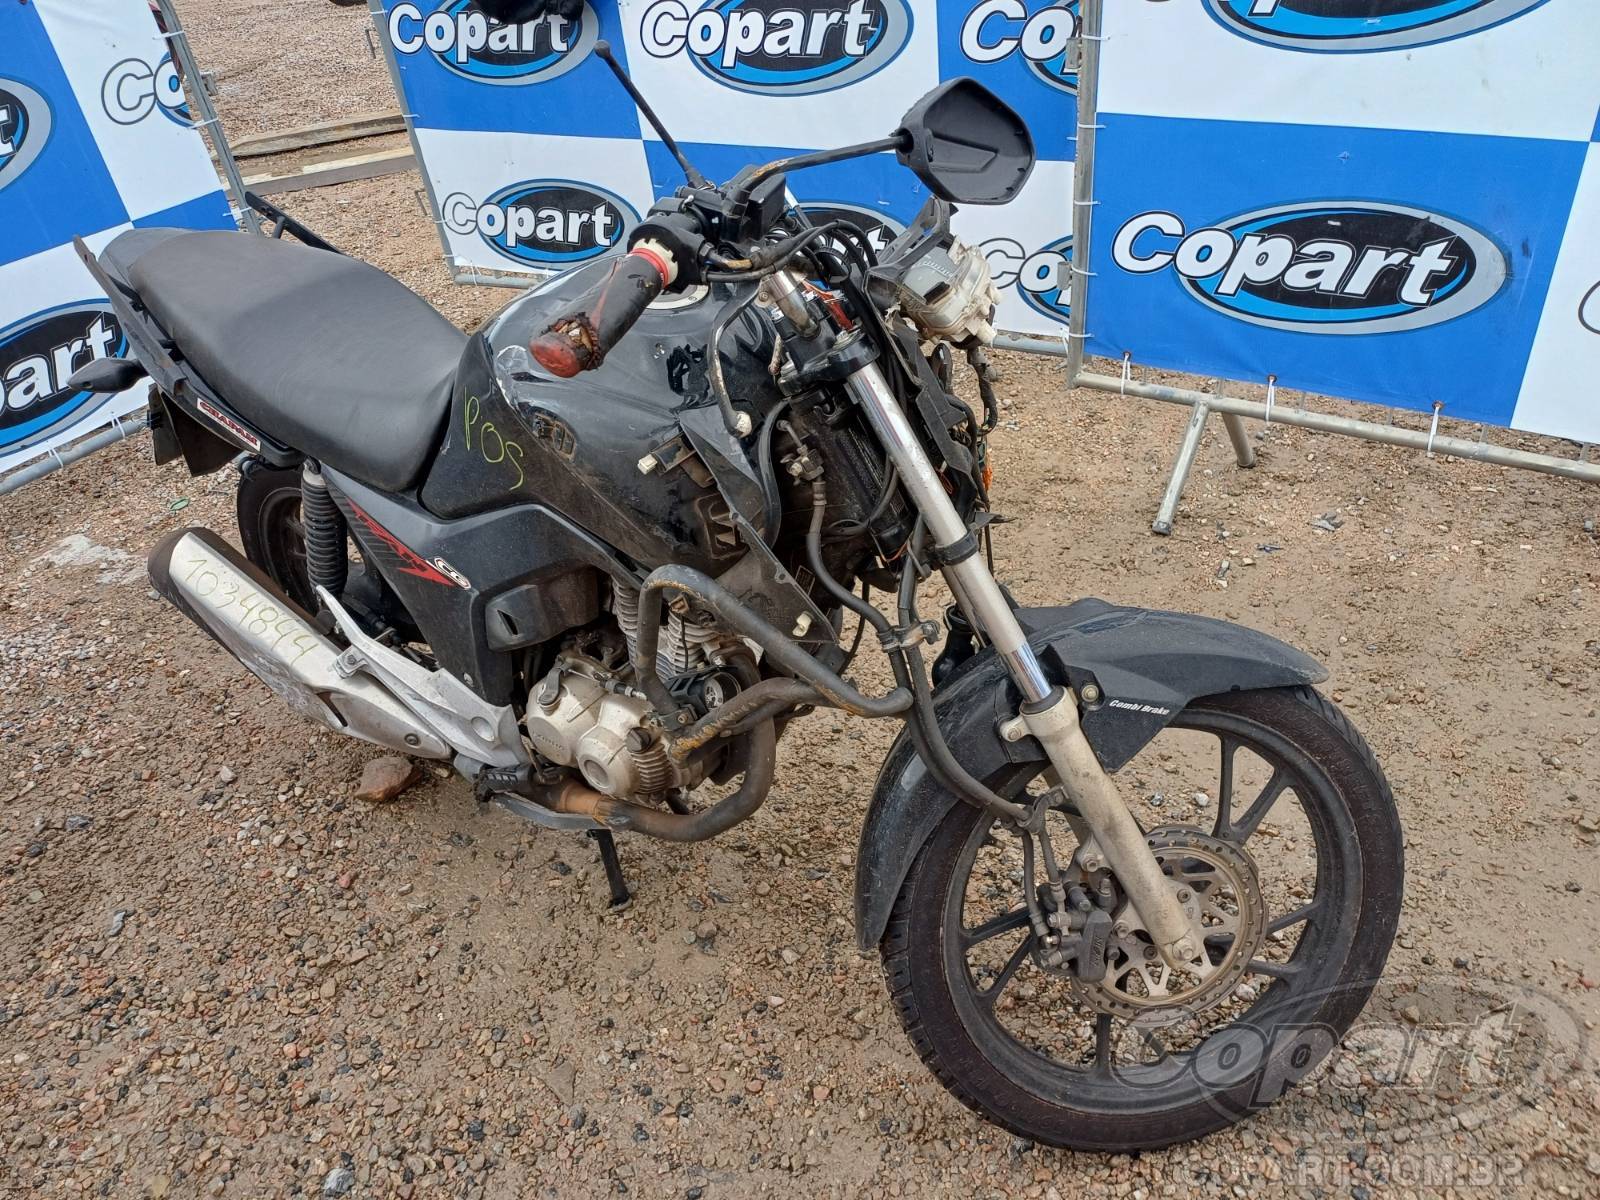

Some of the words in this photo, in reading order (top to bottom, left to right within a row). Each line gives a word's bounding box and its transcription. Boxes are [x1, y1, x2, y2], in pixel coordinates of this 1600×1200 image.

[388, 2, 570, 64] Copart
[640, 0, 876, 69] Copart
[960, 0, 1078, 75] Co
[442, 192, 615, 247] Copart
[978, 237, 1071, 306] Co
[1111, 210, 1459, 307] Copart
[0, 311, 116, 417] art
[1108, 700, 1141, 711] Combi
[1141, 705, 1170, 716] Brake
